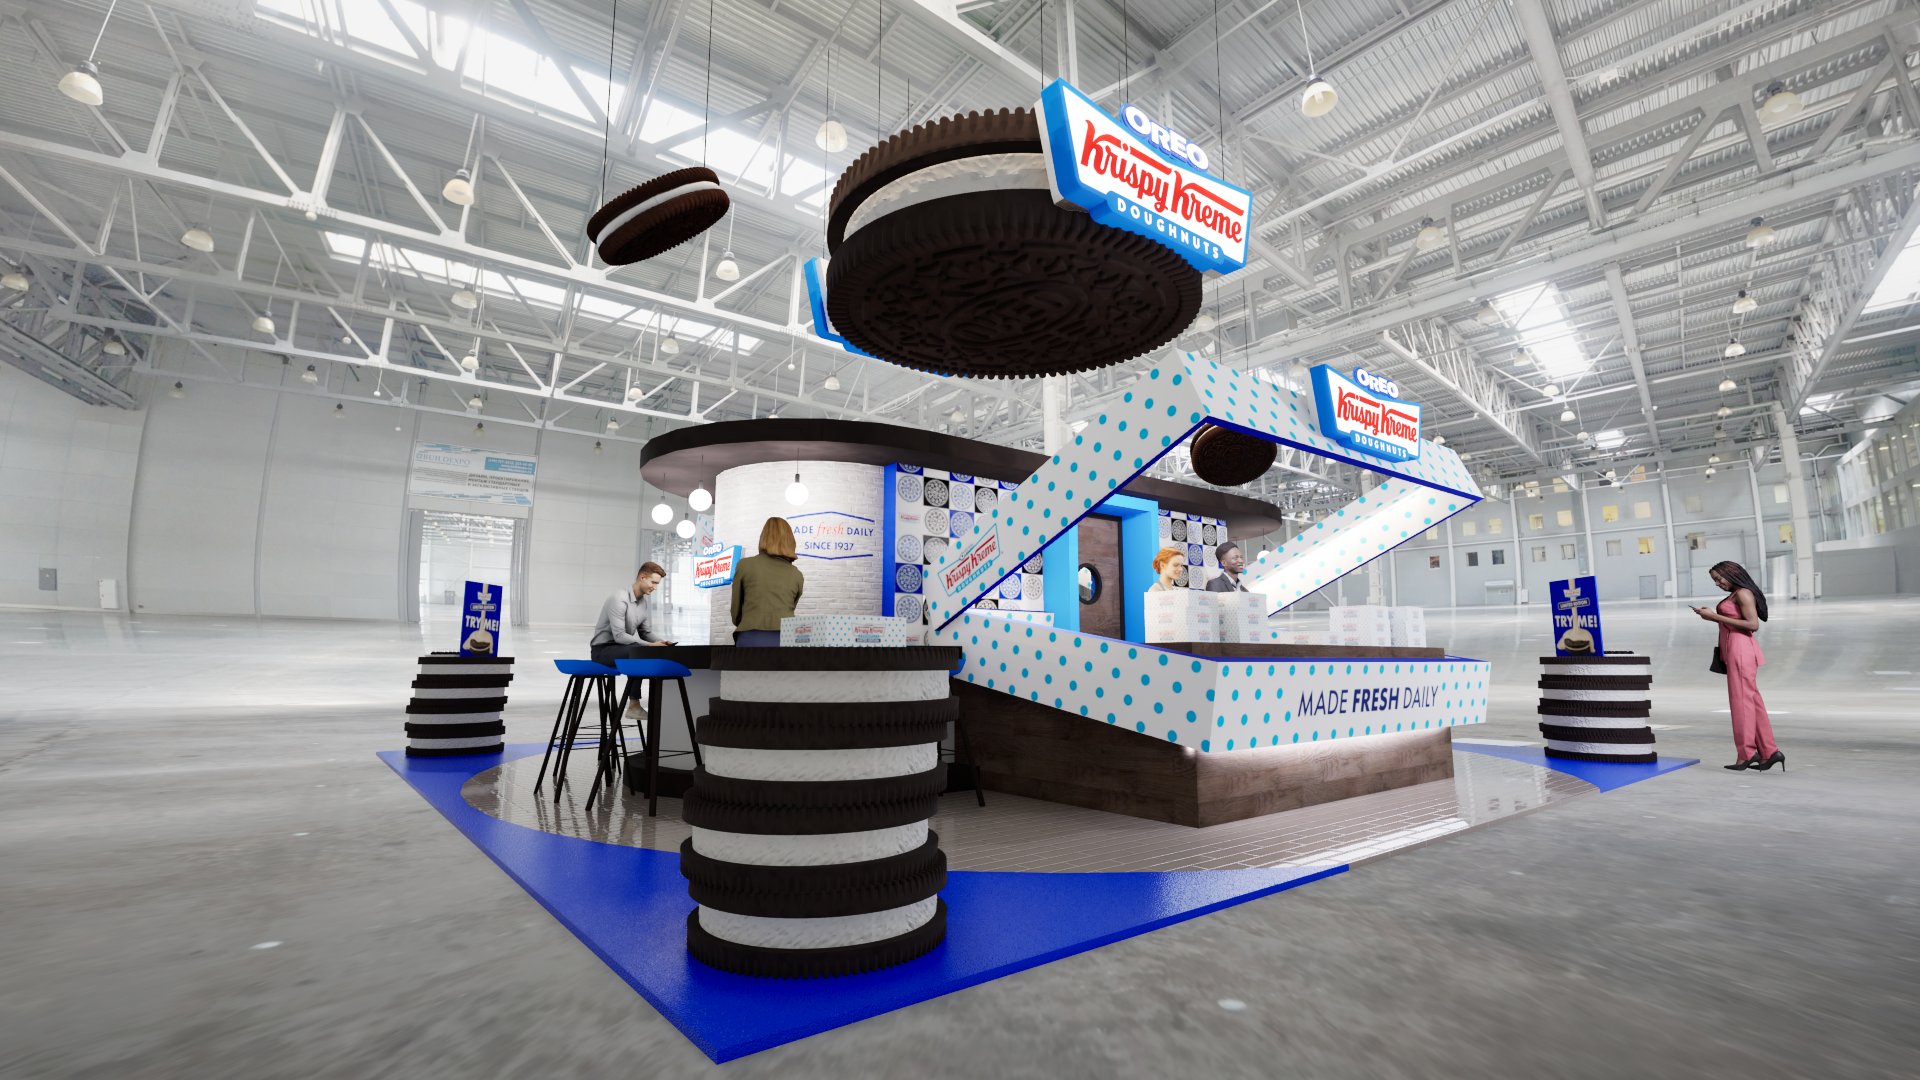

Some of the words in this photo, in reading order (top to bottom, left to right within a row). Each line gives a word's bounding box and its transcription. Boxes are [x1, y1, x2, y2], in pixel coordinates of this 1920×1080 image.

[1123, 104, 1209, 171] OREO
[1081, 119, 1172, 213] Krispy
[1171, 170, 1244, 243] Kreme
[1117, 197, 1219, 259] DOUGHNUTS
[1356, 368, 1399, 399] OREO
[1337, 386, 1380, 436] Krispy
[1380, 403, 1417, 442] Kreme
[423, 453, 471, 466] BUILDEXPO
[1355, 433, 1407, 458] DOUGHNUTS
[789, 526, 813, 534] ADE
[813, 521, 844, 539] fresh
[846, 527, 874, 537] DAILY
[703, 543, 723, 556] OREO
[804, 541, 831, 550] SINCE
[834, 542, 855, 551] 1937
[946, 556, 971, 589] Krispy
[970, 534, 997, 569] Kreme
[465, 615, 482, 629] TRY
[484, 618, 499, 632] ME!
[1554, 615, 1573, 628] TRY
[1577, 615, 1598, 628] ME!
[1297, 689, 1349, 717] MADE
[1352, 687, 1400, 713] FRESH
[1403, 685, 1439, 709] DAILY
